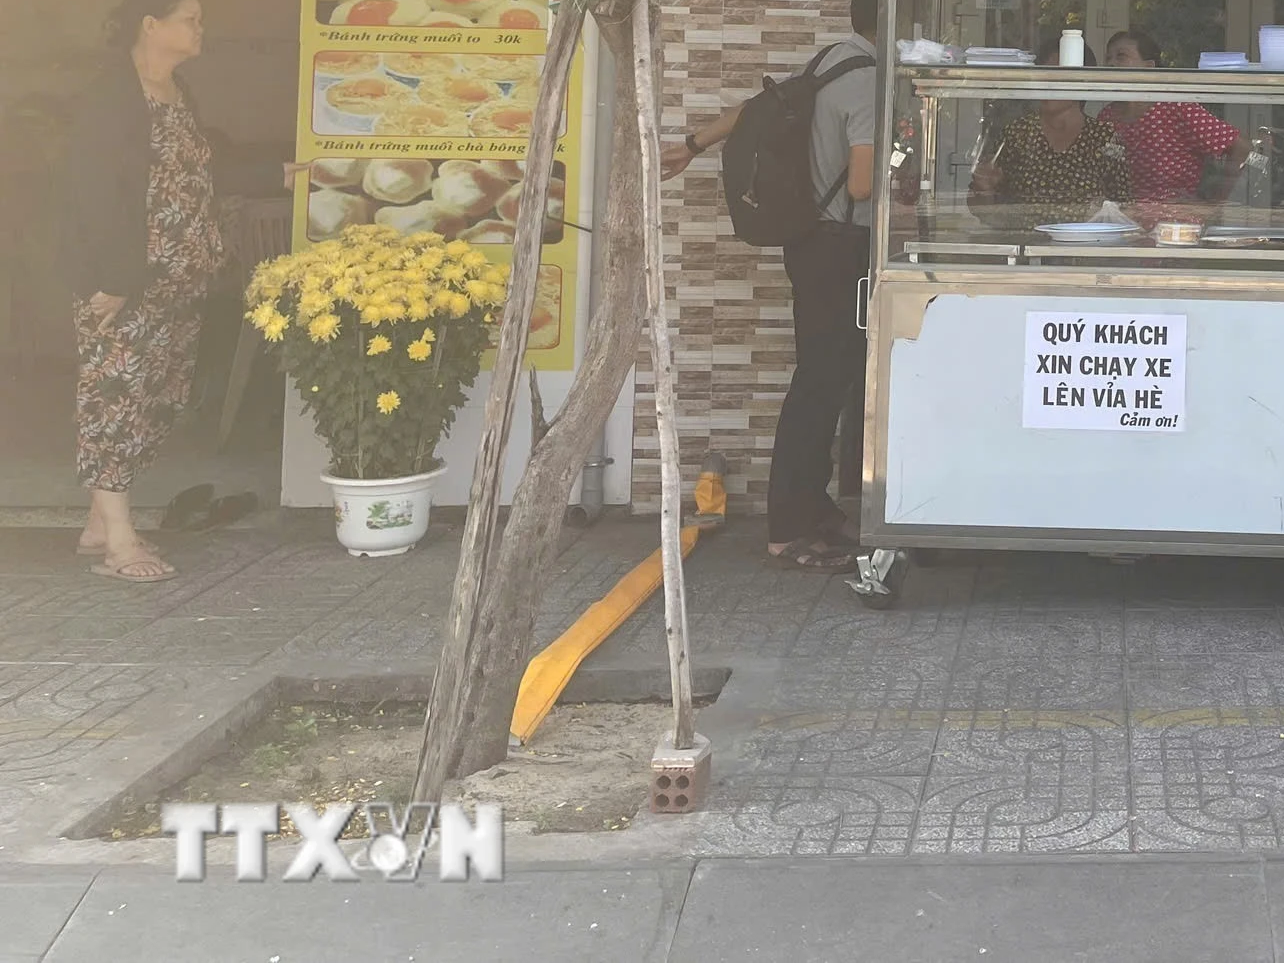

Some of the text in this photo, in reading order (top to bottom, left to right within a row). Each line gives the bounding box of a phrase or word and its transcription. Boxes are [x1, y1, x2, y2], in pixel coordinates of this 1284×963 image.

[326, 30, 370, 42] Bánh
[375, 31, 418, 44] trứng
[467, 34, 481, 44] to
[494, 34, 522, 45] 30k
[322, 140, 364, 151] Bánh
[369, 140, 411, 154] trứng
[457, 141, 485, 153] chà
[489, 142, 526, 154] bông
[1042, 318, 1168, 346] QUÝ KHÁCH
[1036, 354, 1172, 380] XIN CHẠY XE
[1042, 381, 1163, 409] LÊN VỈA HÈ
[1120, 412, 1179, 428] Cảm ơn!
